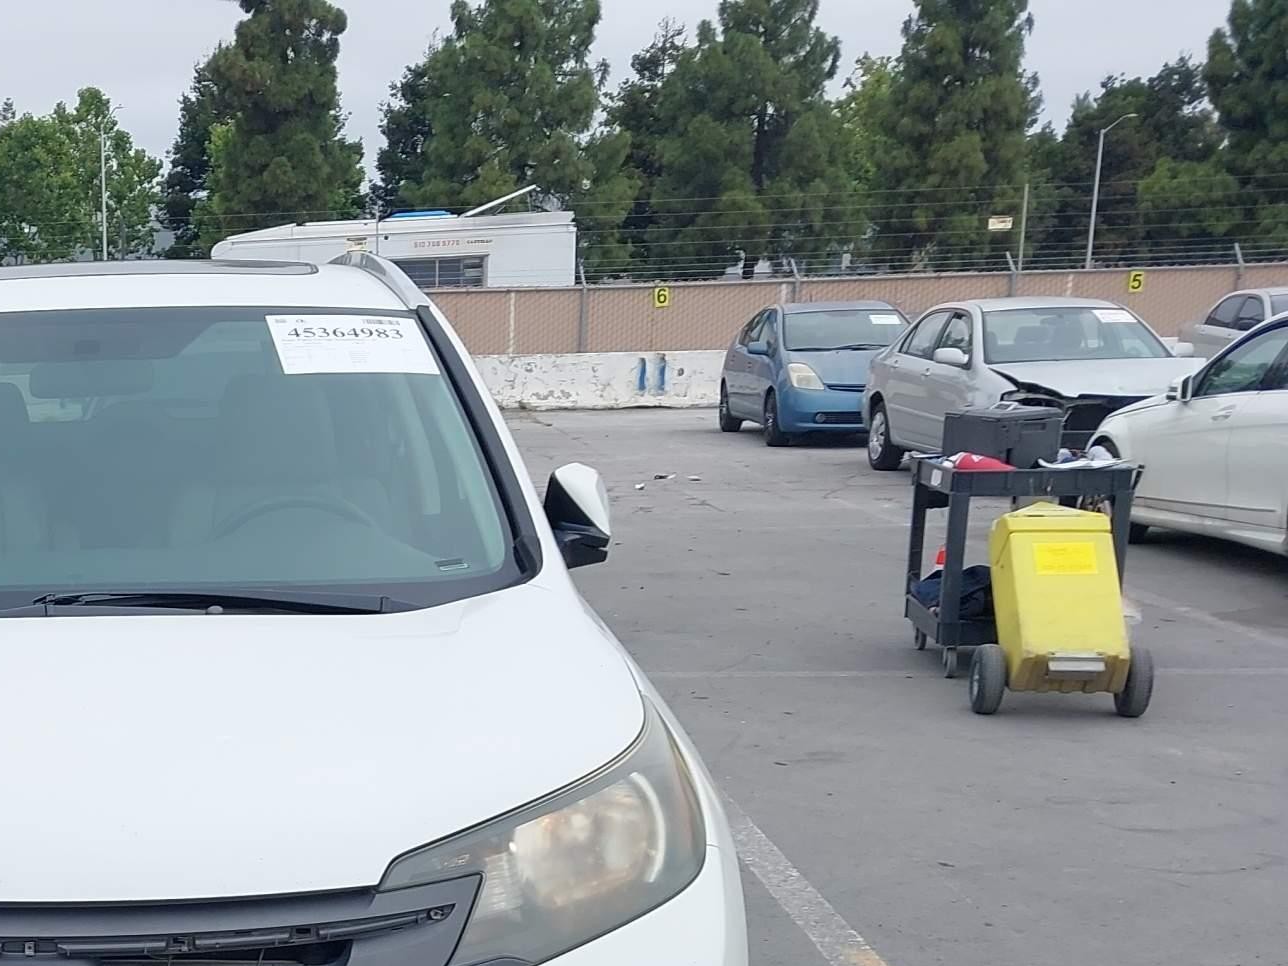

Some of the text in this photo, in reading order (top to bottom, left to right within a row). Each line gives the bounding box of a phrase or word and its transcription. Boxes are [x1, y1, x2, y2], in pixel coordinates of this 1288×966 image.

[1131, 273, 1143, 290] 5
[657, 288, 667, 304] 6
[288, 327, 404, 340] 45364983
